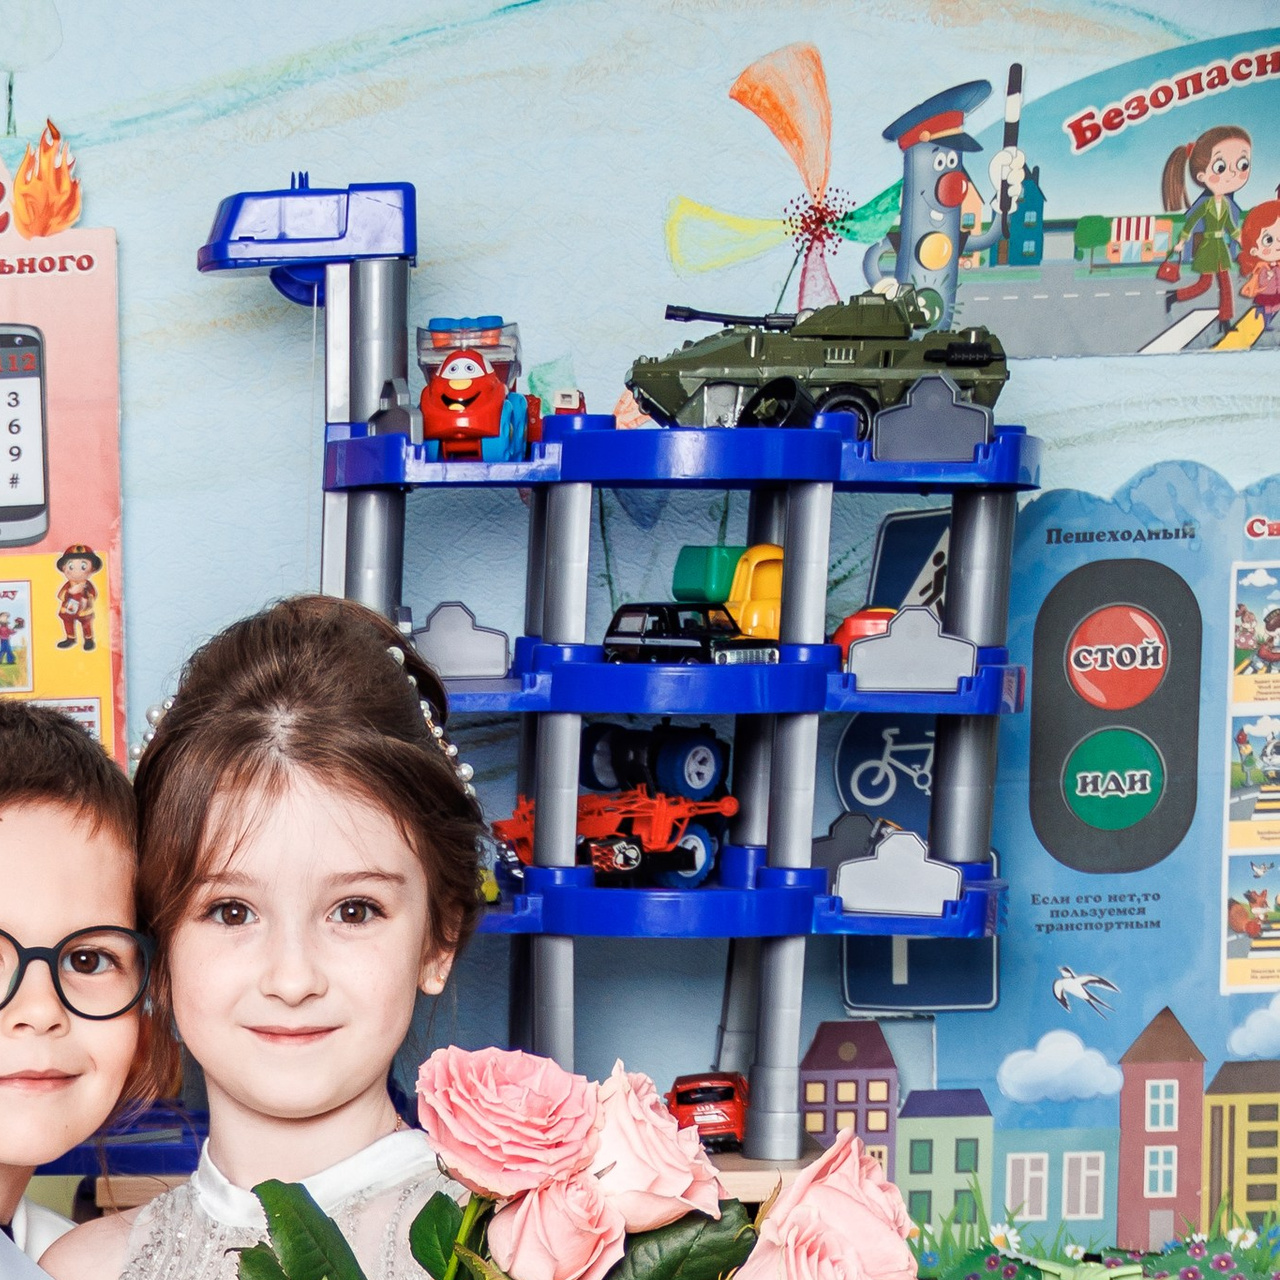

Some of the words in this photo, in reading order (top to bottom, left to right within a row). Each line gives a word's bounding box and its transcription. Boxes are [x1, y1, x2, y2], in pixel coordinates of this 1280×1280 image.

[7, 391, 20, 408] 3
[8, 419, 21, 435] 6
[9, 446, 22, 462] 9
[1046, 520, 1196, 544] Пешеходный
[1030, 894, 1070, 905] Если
[1075, 895, 1102, 904] его
[1049, 906, 1146, 919] пользуемся
[1035, 919, 1161, 934] транспортным
